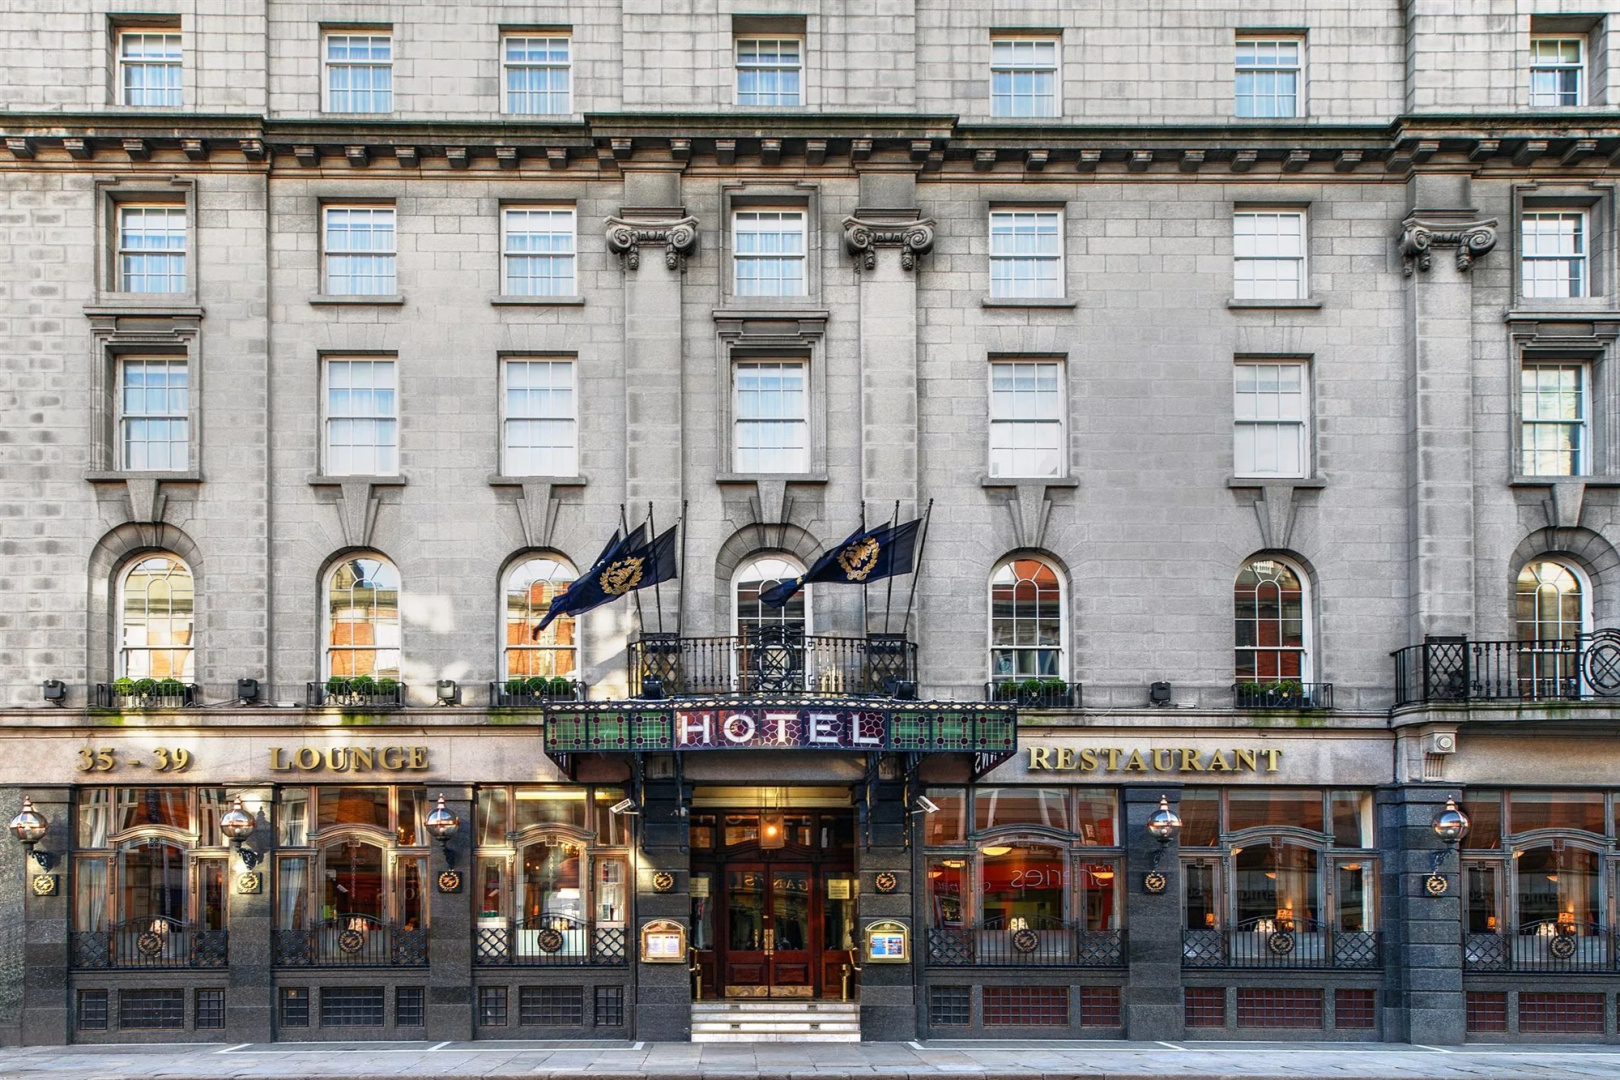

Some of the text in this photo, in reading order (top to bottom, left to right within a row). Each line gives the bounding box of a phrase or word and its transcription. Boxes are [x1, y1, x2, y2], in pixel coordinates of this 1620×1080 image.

[681, 714, 879, 744] HOTEL
[76, 747, 115, 772] 35
[153, 747, 189, 772] 39
[269, 747, 429, 771] LOUNGE
[1027, 747, 1281, 772] RESTAURANT
